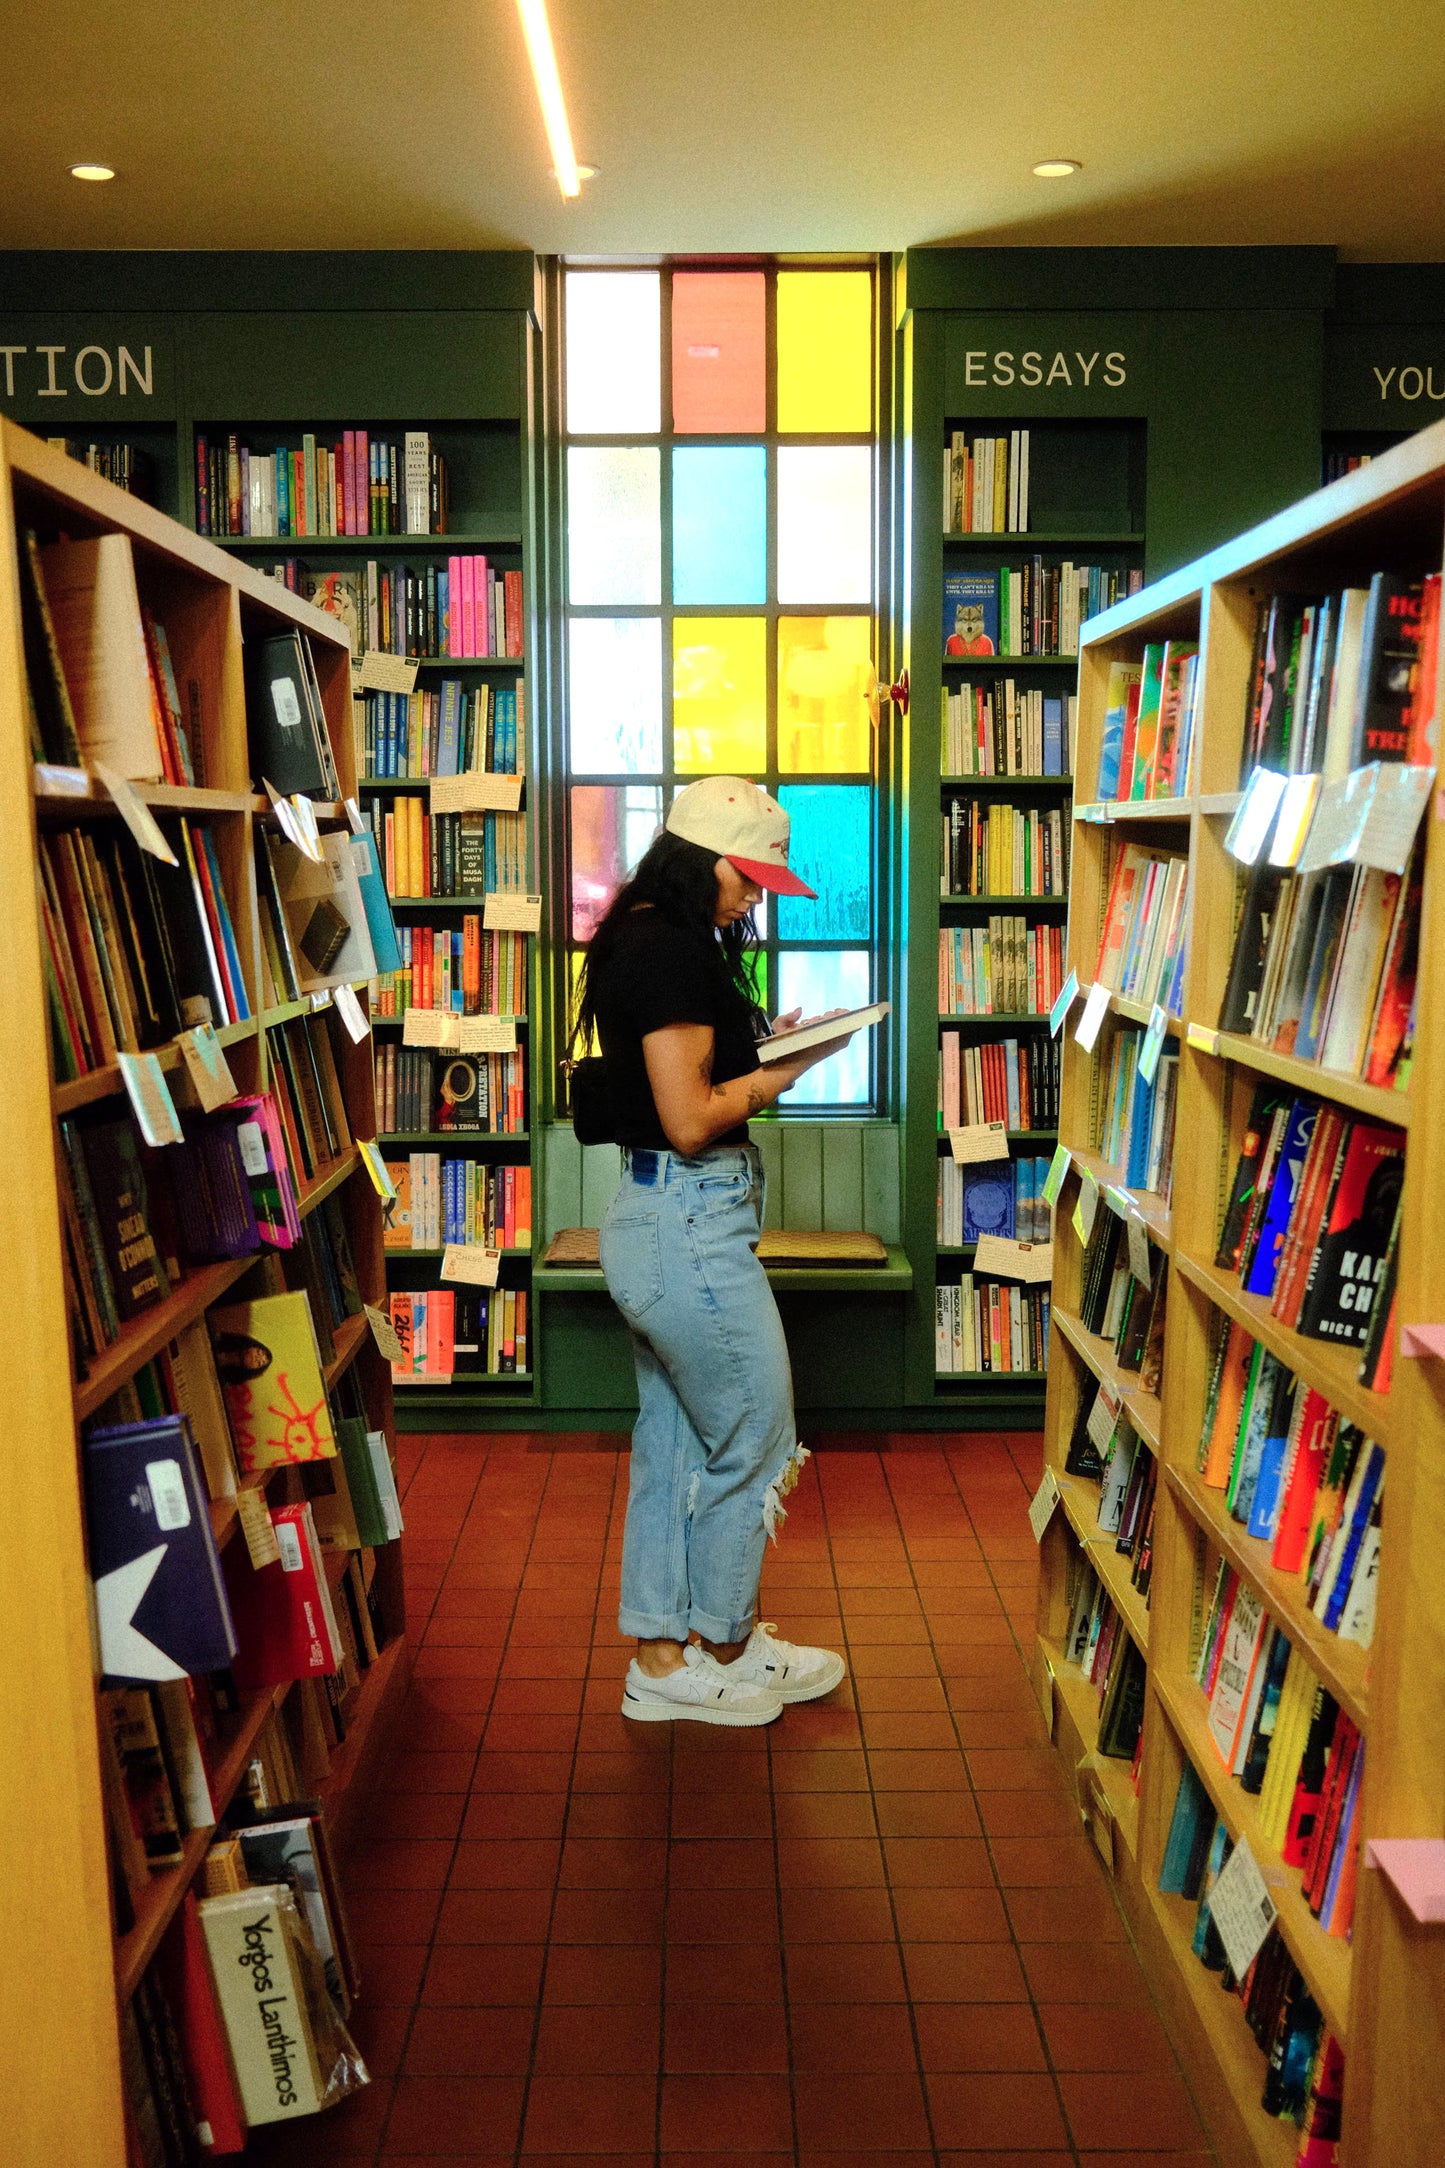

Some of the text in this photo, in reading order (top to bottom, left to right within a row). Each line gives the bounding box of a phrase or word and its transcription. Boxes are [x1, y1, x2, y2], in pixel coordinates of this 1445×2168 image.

[965, 351, 1126, 386] ESSAYS
[229, 436, 237, 451] LIKE
[444, 682, 455, 746] INFINITE JEST
[238, 1914, 298, 2106] Yorgos Lanthimos
